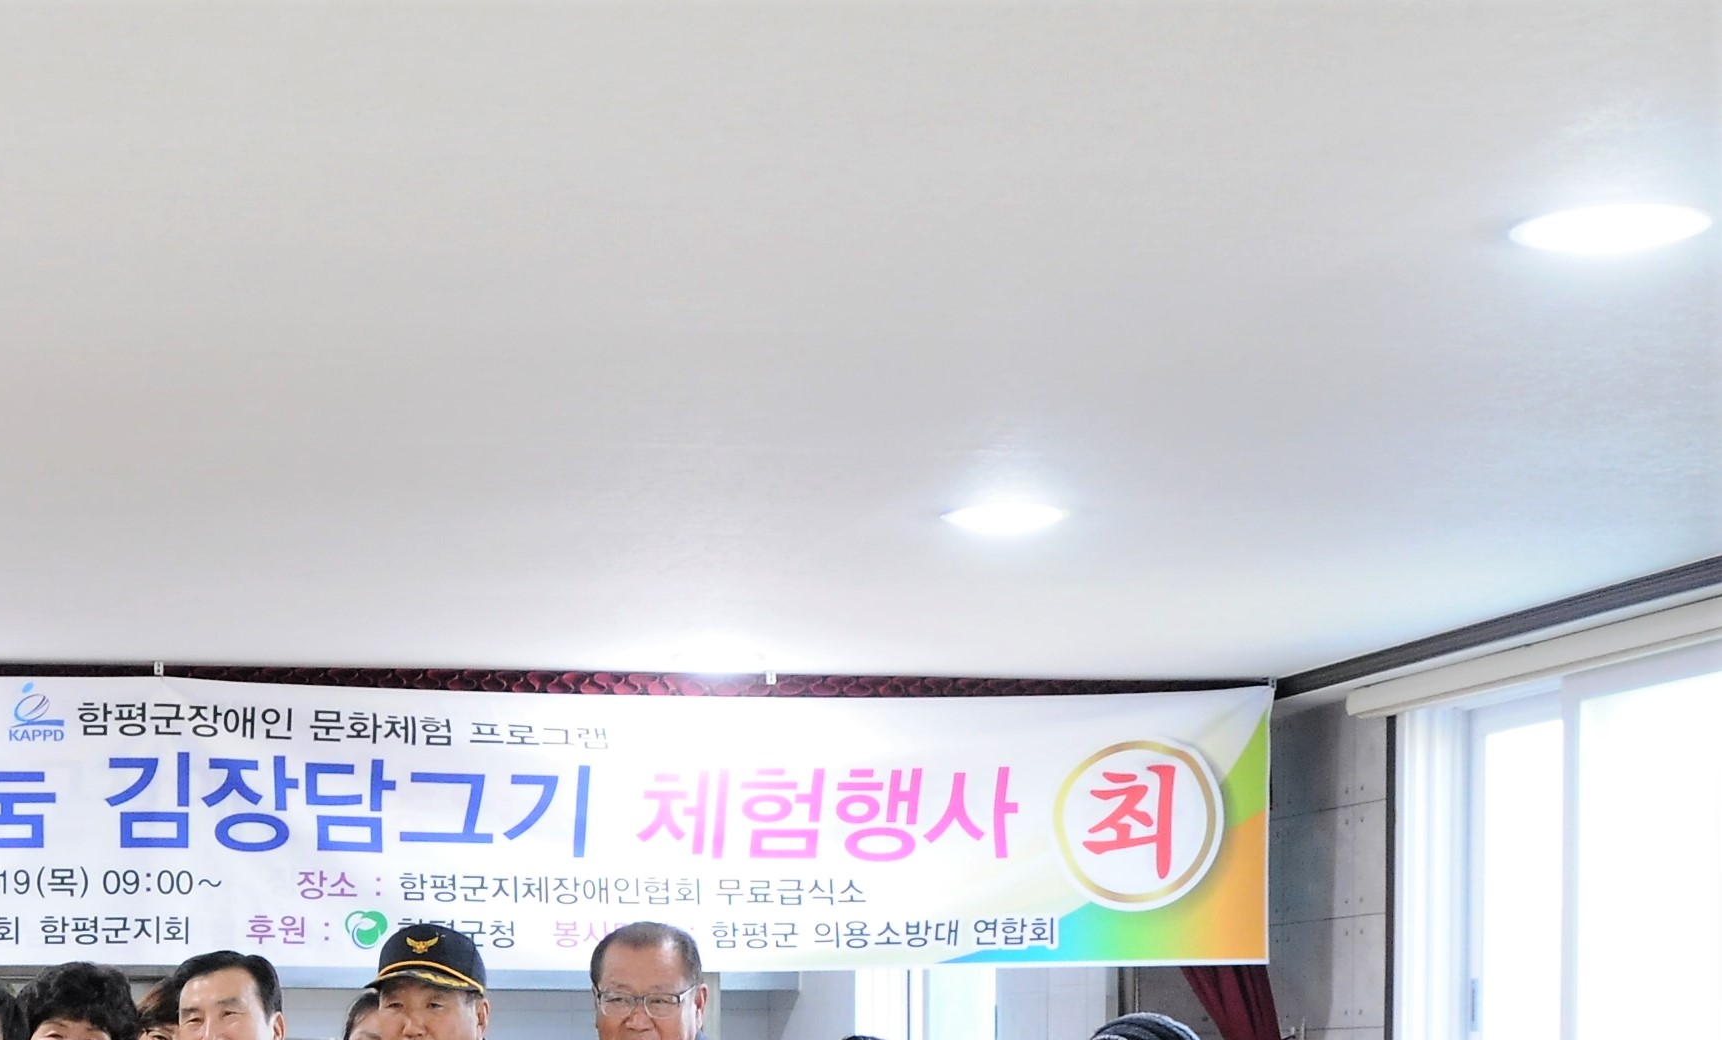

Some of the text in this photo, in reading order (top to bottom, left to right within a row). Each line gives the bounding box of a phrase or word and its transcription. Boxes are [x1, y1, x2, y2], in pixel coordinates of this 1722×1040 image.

[9, 729, 65, 742] KAPPD
[77, 701, 609, 750] 함평군장애인 문화체험 프로그램
[105, 749, 597, 858] 김장담그기
[636, 764, 1019, 861] 체험행사
[1083, 763, 1173, 879] 최
[296, 871, 359, 900] 장소
[399, 872, 701, 905] 함평군지체장애인협회
[716, 878, 867, 906] 무료급식소
[40, 915, 191, 946] 함평군지회
[245, 914, 307, 945] 후원
[711, 917, 1055, 949] 함평군 의용소방대 연합회
